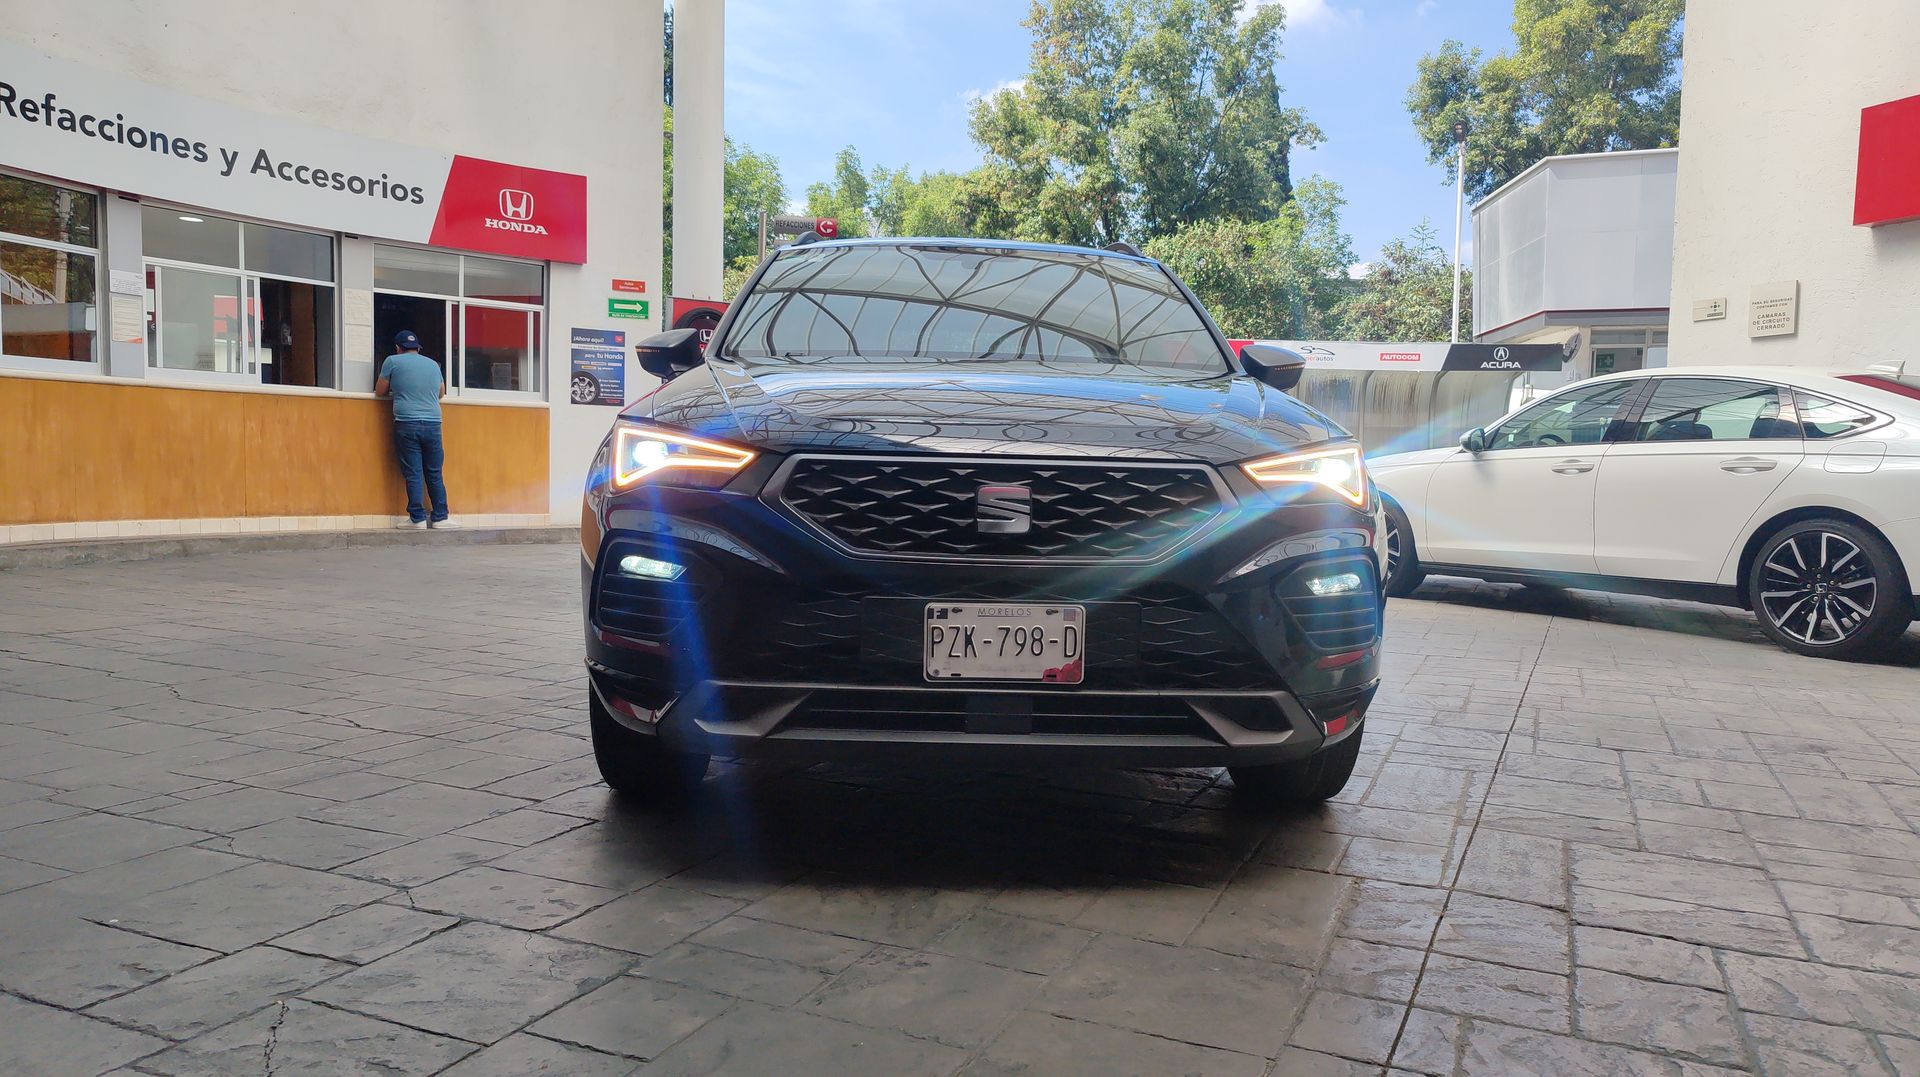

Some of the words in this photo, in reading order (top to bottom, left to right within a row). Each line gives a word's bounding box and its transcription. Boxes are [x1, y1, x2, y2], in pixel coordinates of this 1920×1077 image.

[0, 81, 209, 163] Refacciones
[219, 147, 239, 177] y
[250, 148, 425, 205] Accesorios
[484, 217, 549, 236] HONDA
[775, 219, 815, 230] REFACCIONES
[1761, 316, 1791, 325] CIRCUITO
[1756, 322, 1786, 331] CERRADO
[604, 352, 624, 360] Honda
[1382, 353, 1420, 361] AUTOCOM
[1480, 361, 1522, 369] ACURA
[977, 607, 1032, 617] MORELOS
[930, 624, 1079, 658] PZK-798-D
